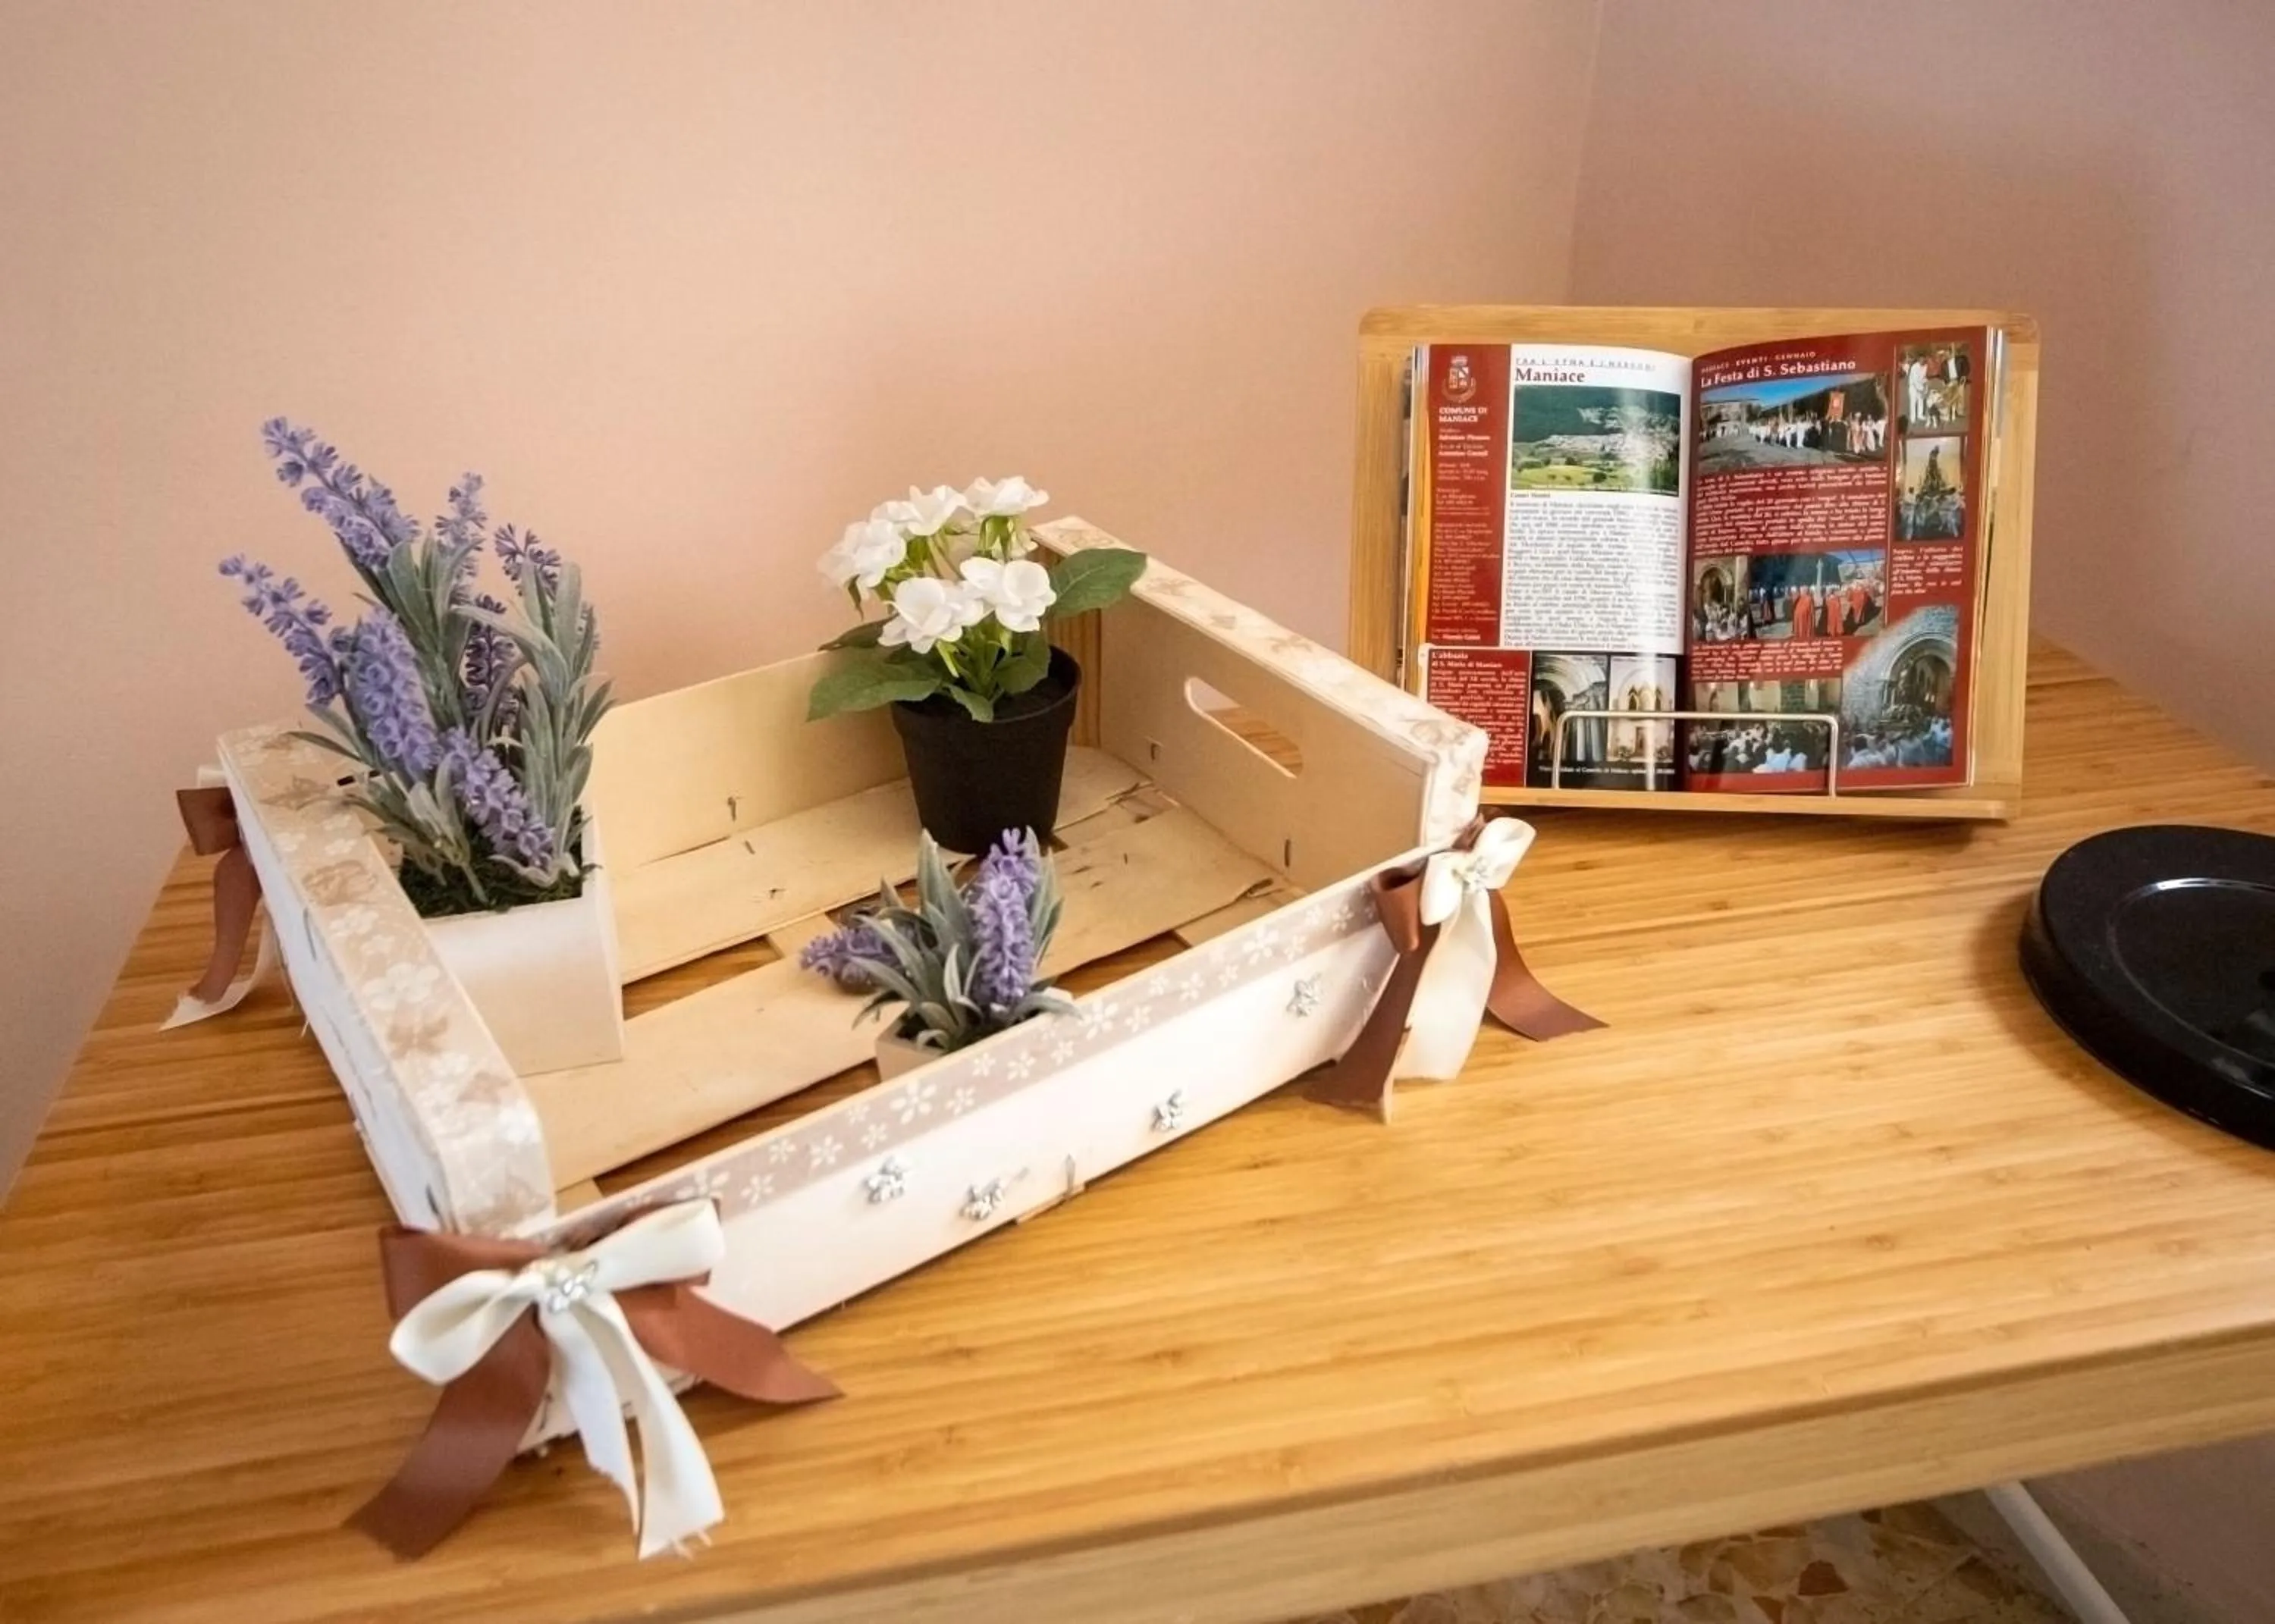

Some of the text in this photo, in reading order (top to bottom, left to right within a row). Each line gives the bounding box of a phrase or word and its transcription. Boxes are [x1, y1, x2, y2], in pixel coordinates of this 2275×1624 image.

[1515, 367, 1586, 383] Maniace
[1701, 359, 1856, 388] La Festa di S. Sebastiano
